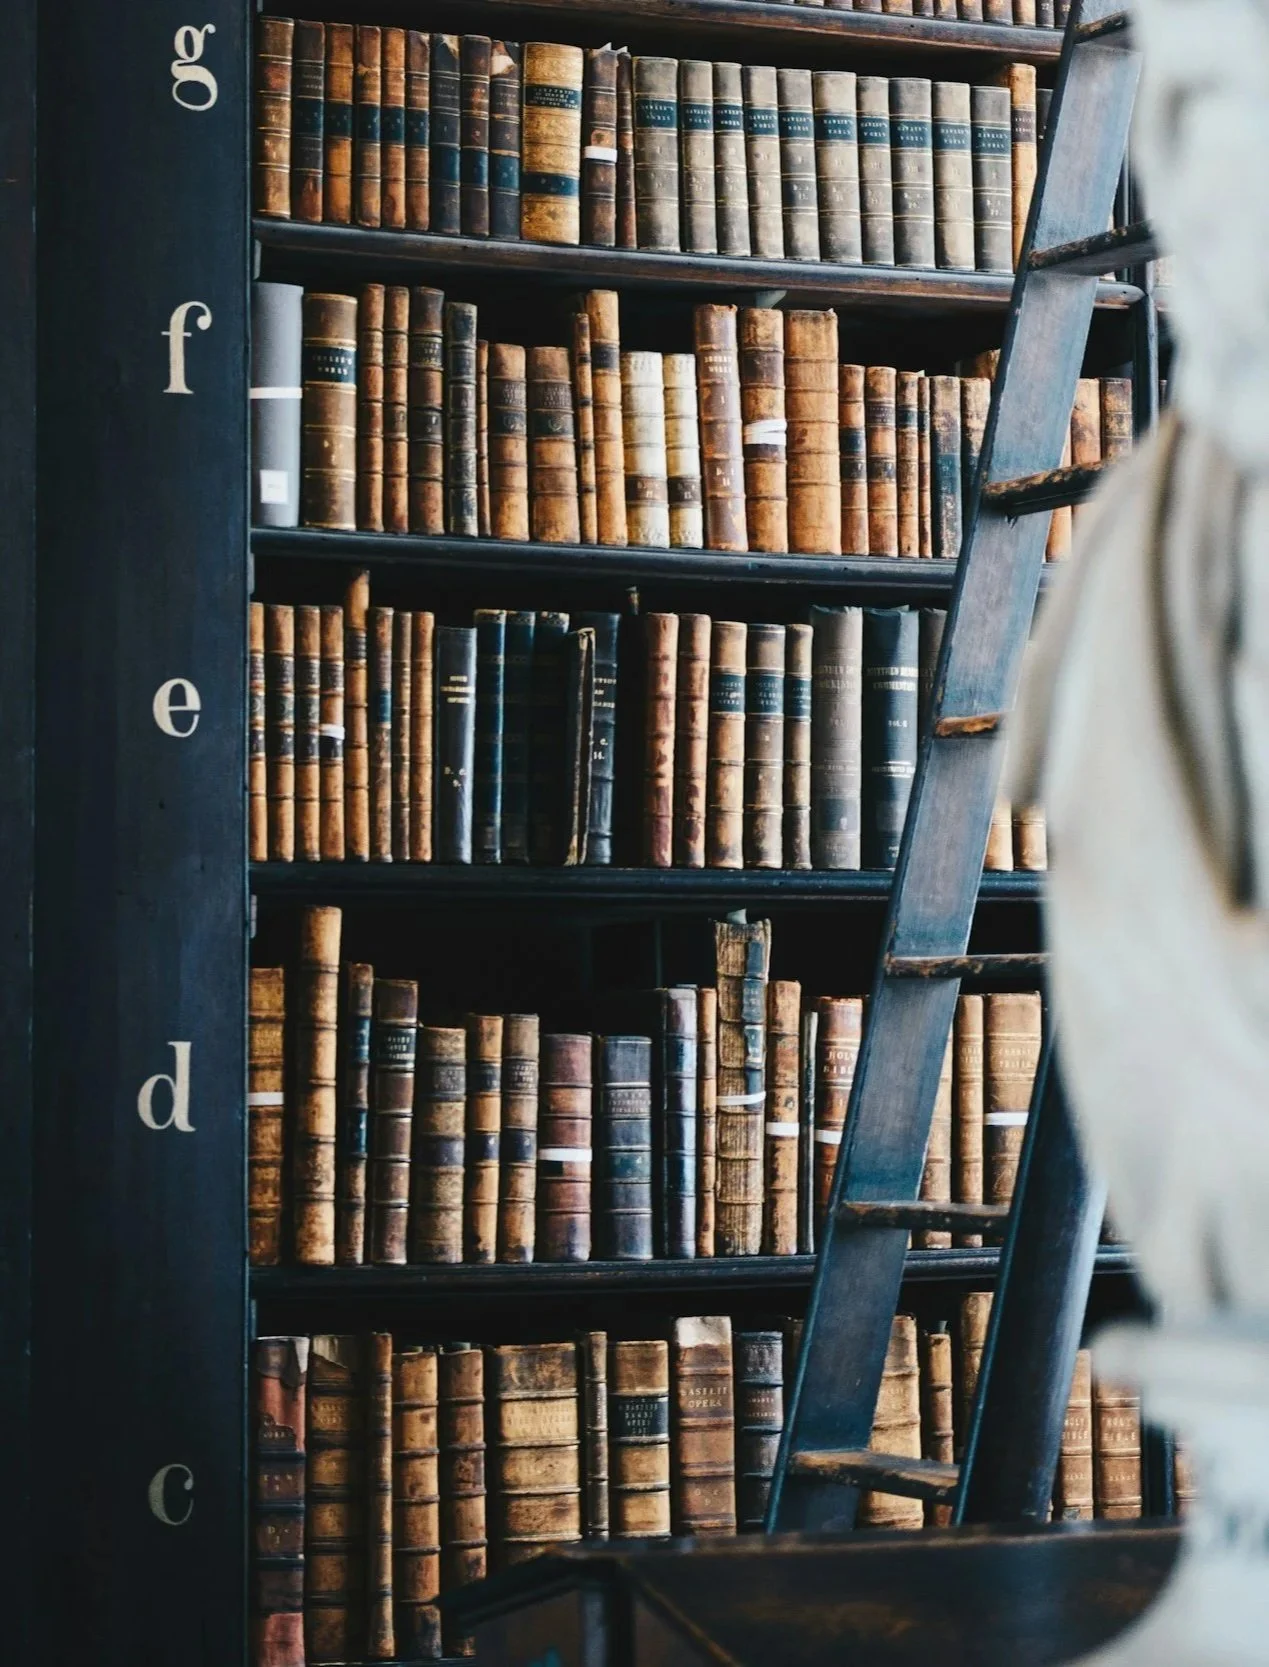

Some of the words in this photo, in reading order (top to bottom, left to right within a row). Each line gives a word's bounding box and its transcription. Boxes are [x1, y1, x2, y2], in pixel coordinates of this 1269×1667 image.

[171, 24, 218, 111] g
[162, 301, 212, 394] f
[153, 678, 201, 737] e
[823, 1065, 852, 1074] BIBL
[829, 1051, 854, 1060] HOLY
[138, 1041, 195, 1132] d
[688, 1399, 722, 1408] OPERA
[148, 1463, 194, 1526] c
